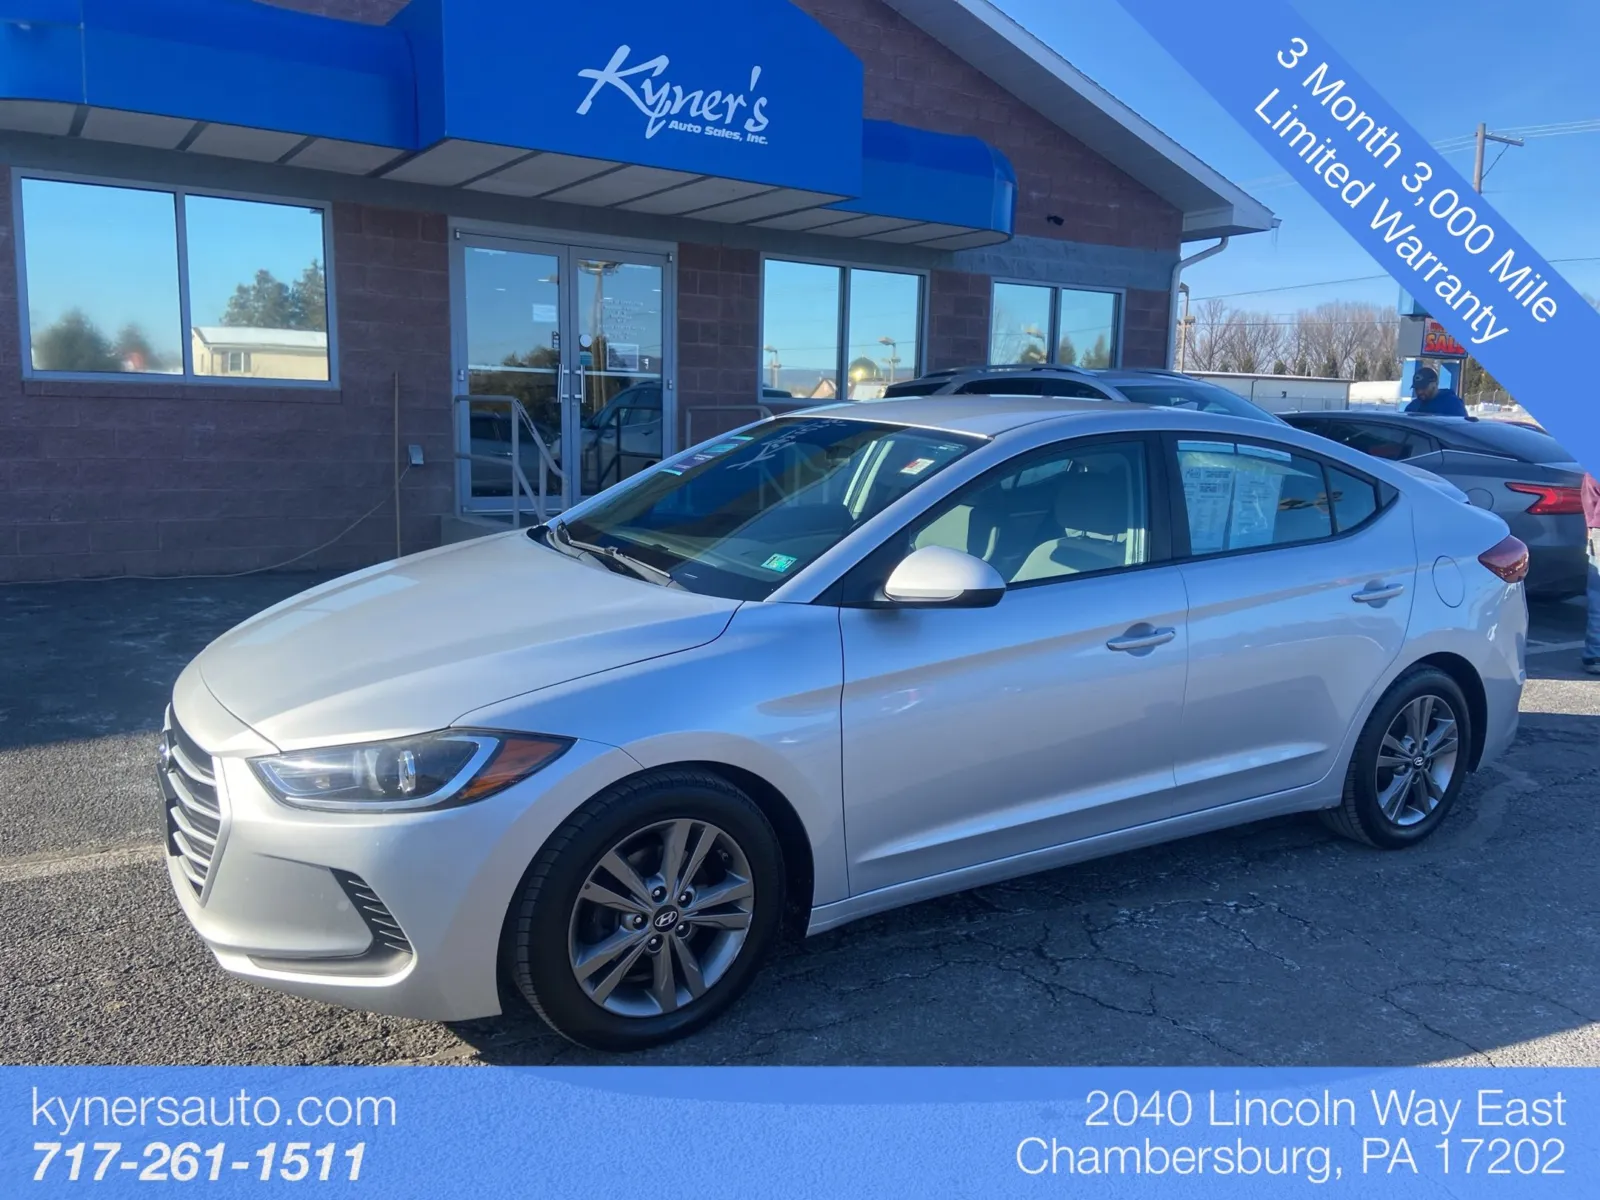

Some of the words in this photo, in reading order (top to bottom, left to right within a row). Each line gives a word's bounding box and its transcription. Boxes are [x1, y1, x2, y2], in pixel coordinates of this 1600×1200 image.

[576, 44, 769, 139] Kyner's
[668, 120, 702, 134] Auto
[704, 125, 743, 142] Sales,
[746, 133, 769, 145] Inc.
